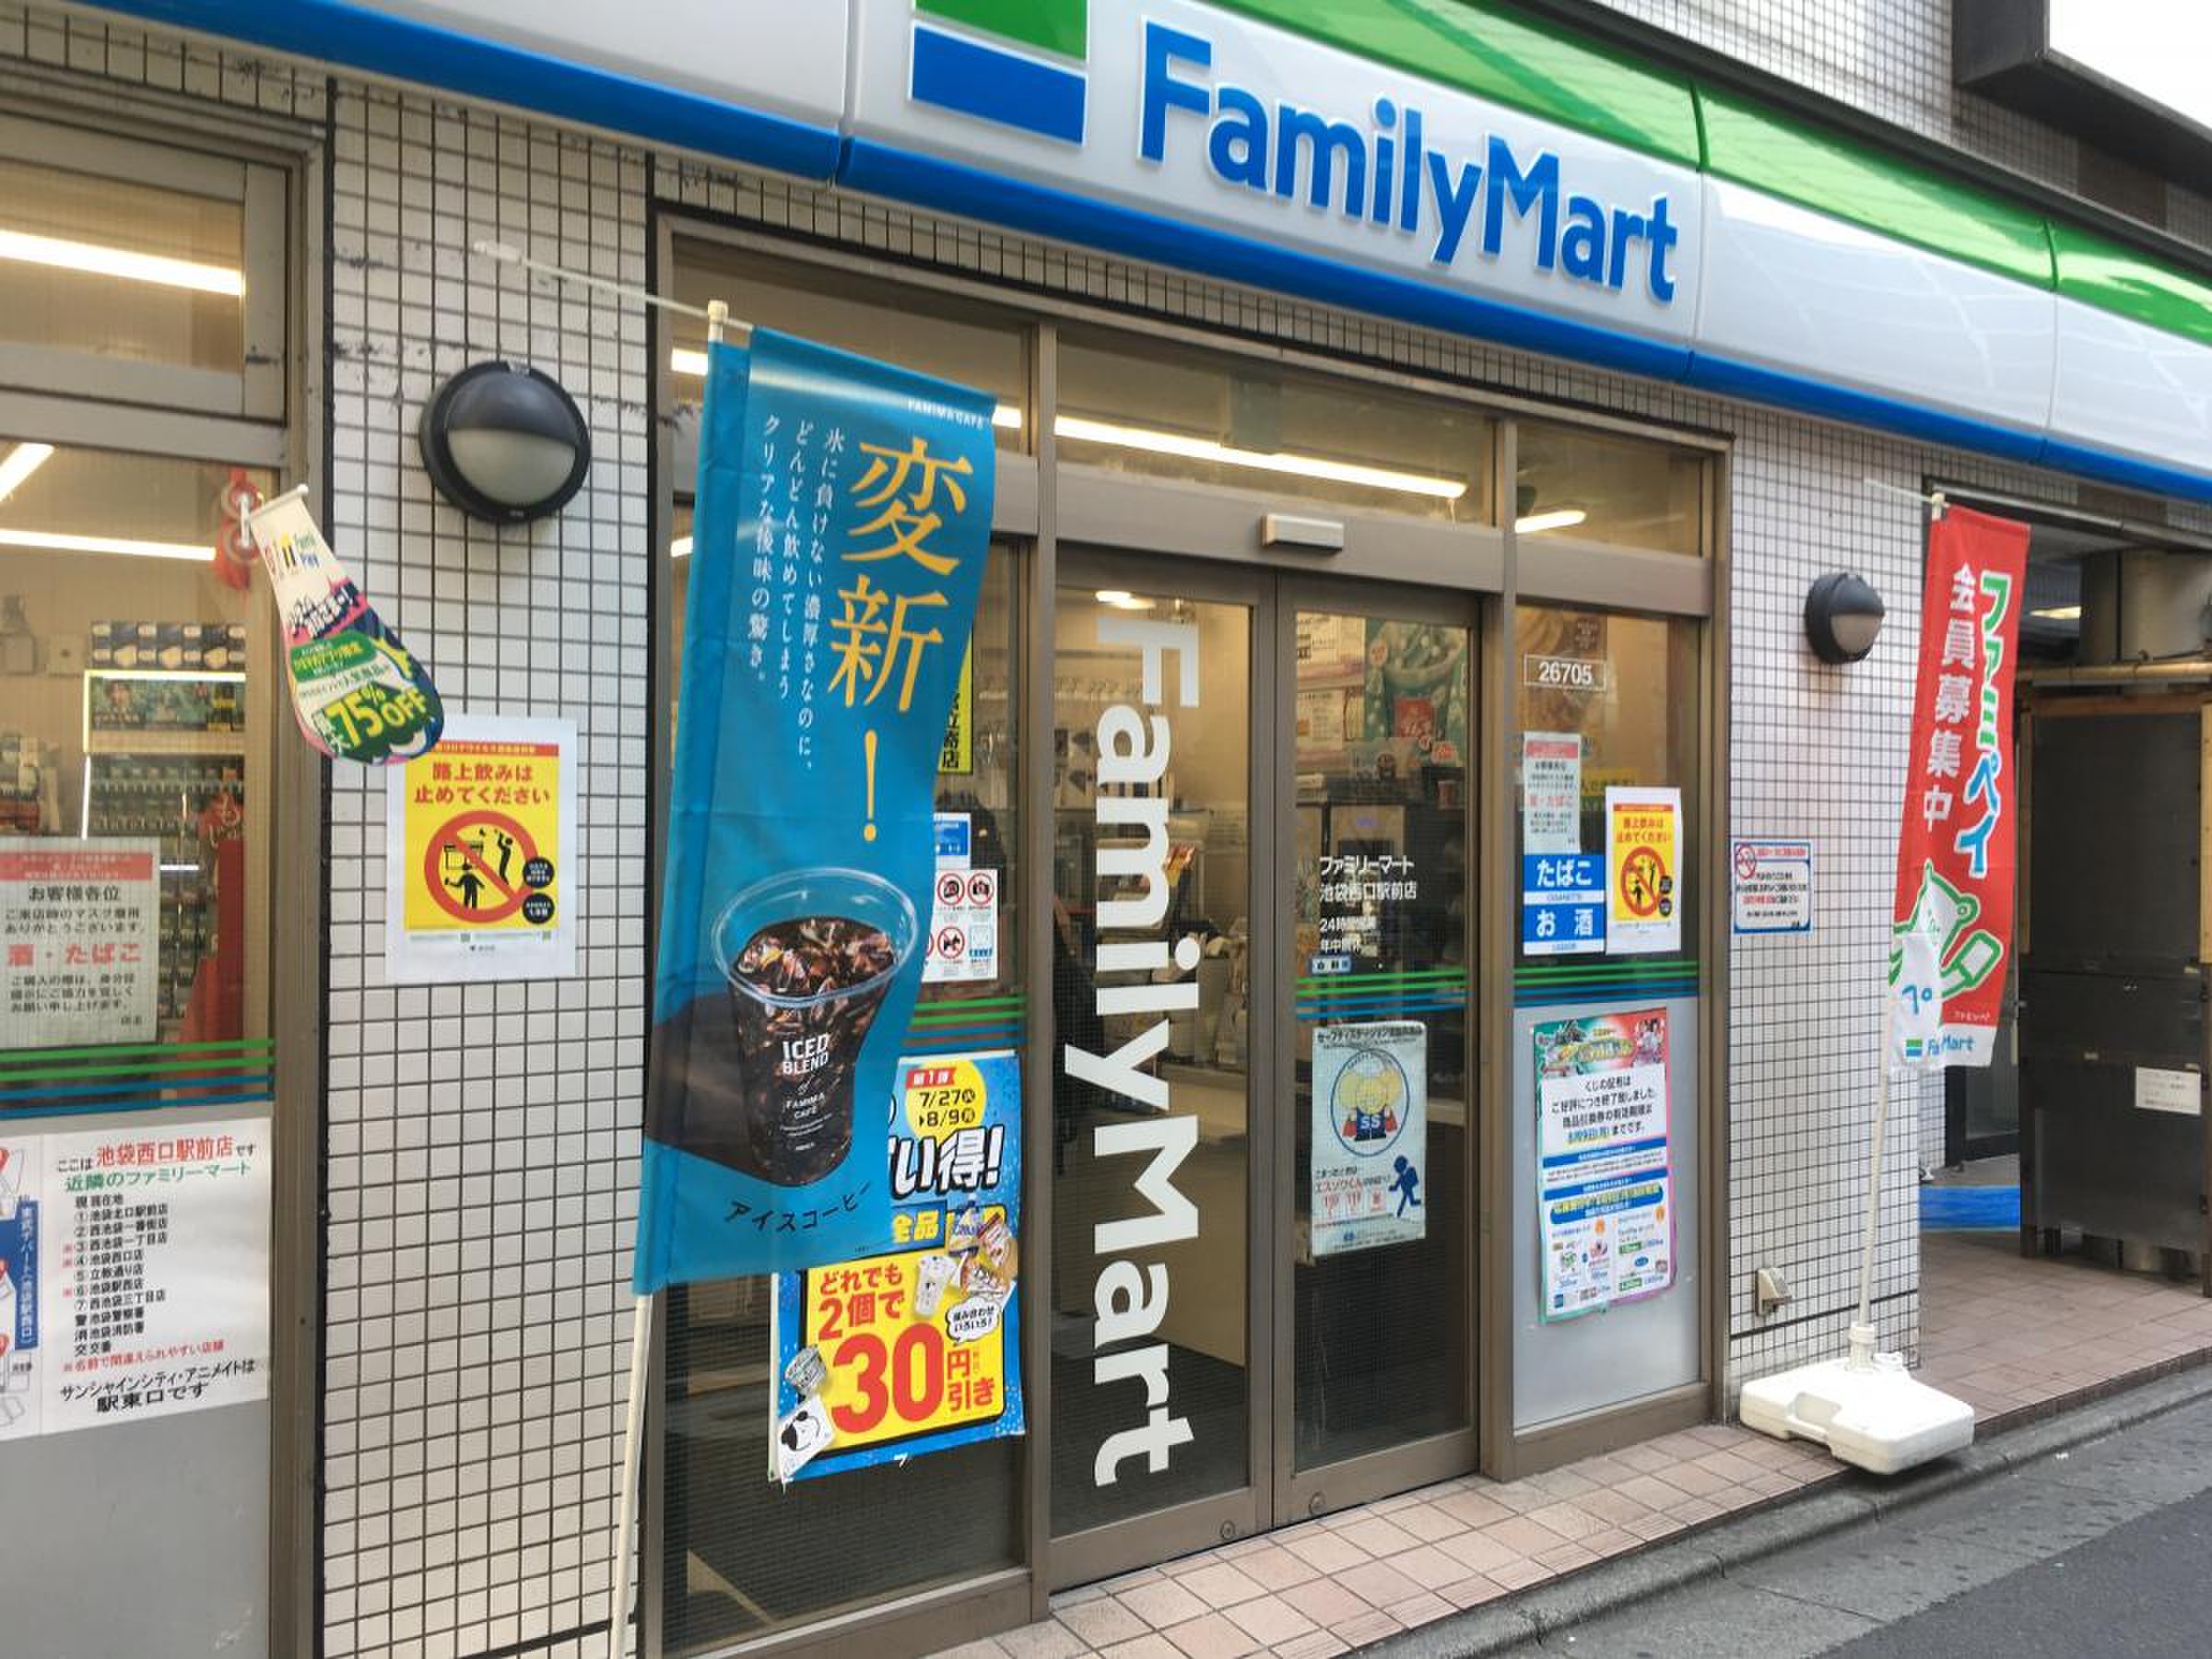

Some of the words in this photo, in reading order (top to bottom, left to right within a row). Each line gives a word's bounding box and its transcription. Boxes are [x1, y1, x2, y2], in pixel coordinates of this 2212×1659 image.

[1138, 16, 1677, 302] FamilyMart
[1538, 661, 1593, 686] 26705
[1924, 561, 1977, 831] 会員募集中
[1954, 569, 2012, 879] ファミペイ
[432, 762, 532, 782] 路上飲みは
[414, 784, 550, 805] 止めてください
[1320, 855, 1415, 876] ファミリーマート
[1536, 858, 1593, 888] たばこ
[1320, 881, 1417, 902] 池袋西口駅前店
[782, 1032, 829, 1061] ICED
[1065, 618, 1199, 1487] FamilyMart
[782, 1052, 829, 1075] BLEND
[65, 1161, 252, 1193] 近隣のファミリーマート
[724, 1181, 871, 1232] アイスコーヒー
[819, 1264, 903, 1297] どれでも
[818, 1292, 906, 1341] 2個で
[830, 1323, 945, 1435] 30
[97, 1382, 209, 1413] 駅東口です
